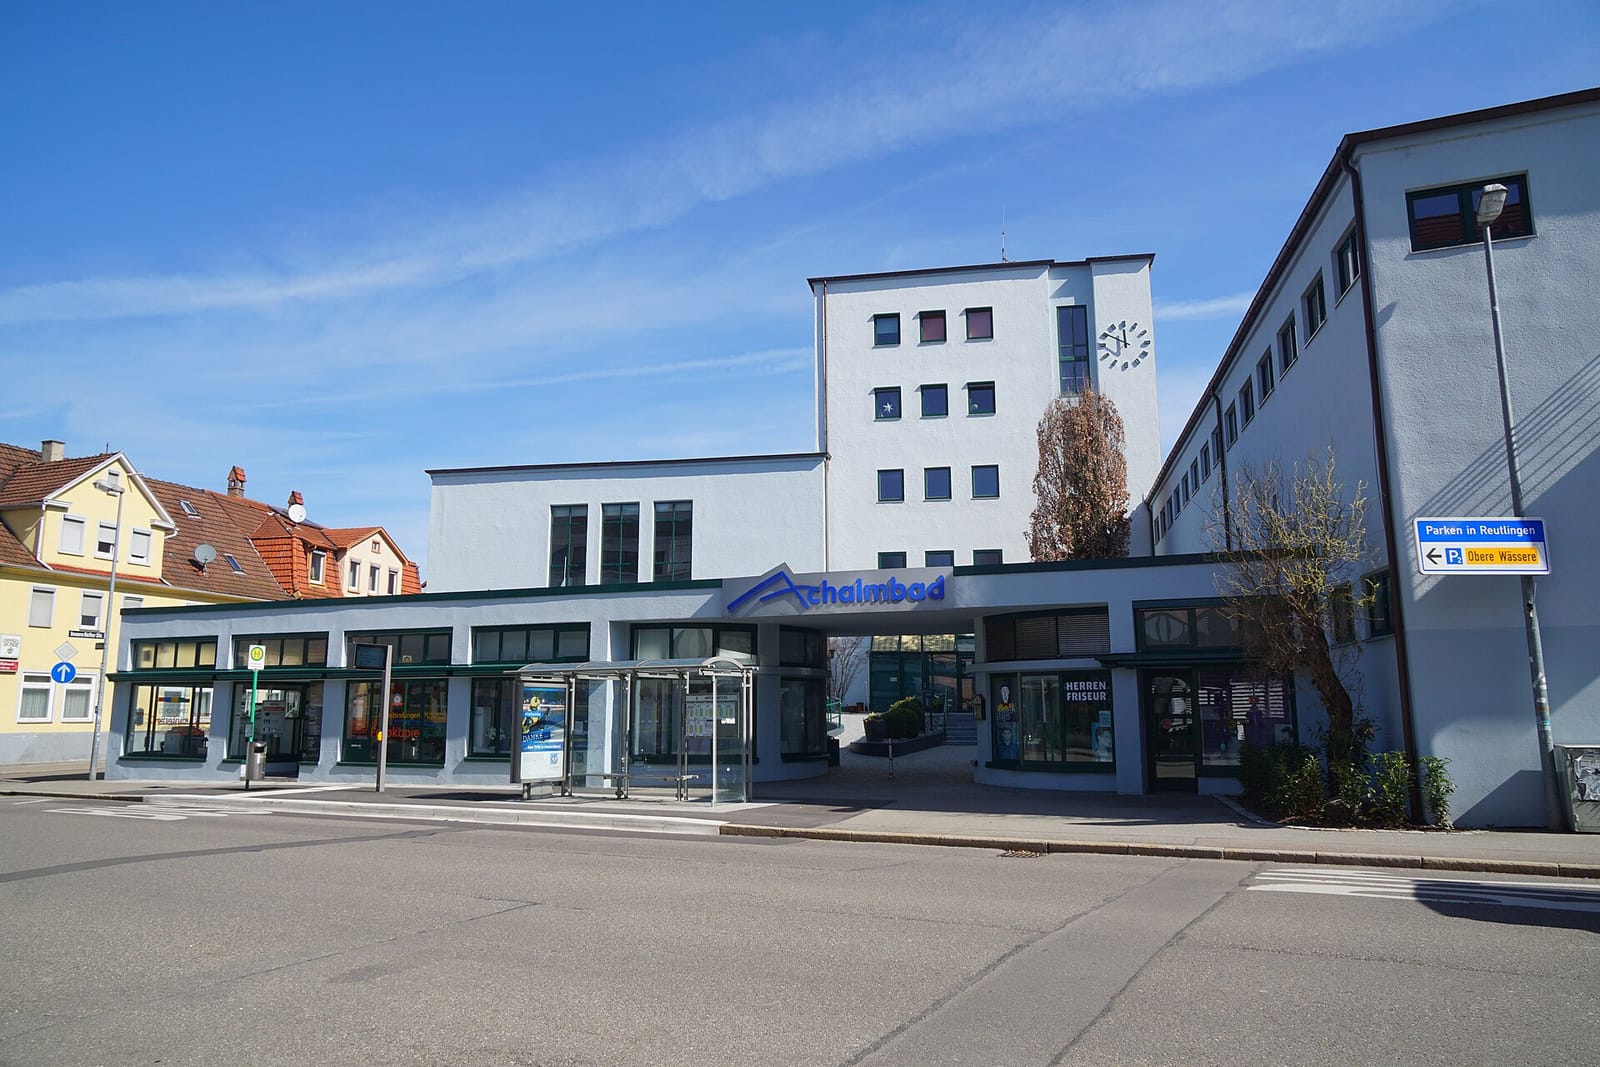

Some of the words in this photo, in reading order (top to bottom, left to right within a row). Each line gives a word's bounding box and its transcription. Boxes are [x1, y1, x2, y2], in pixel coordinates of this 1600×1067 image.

[1425, 525, 1463, 535] Parken
[1466, 525, 1477, 535] in
[1479, 525, 1536, 537] Reutlingen
[1467, 550, 1495, 562] Obere
[1498, 550, 1537, 562] Wässere
[727, 571, 945, 609] Achalmbad
[1066, 681, 1107, 691] HERREN
[1066, 692, 1107, 701] FRISEUR
